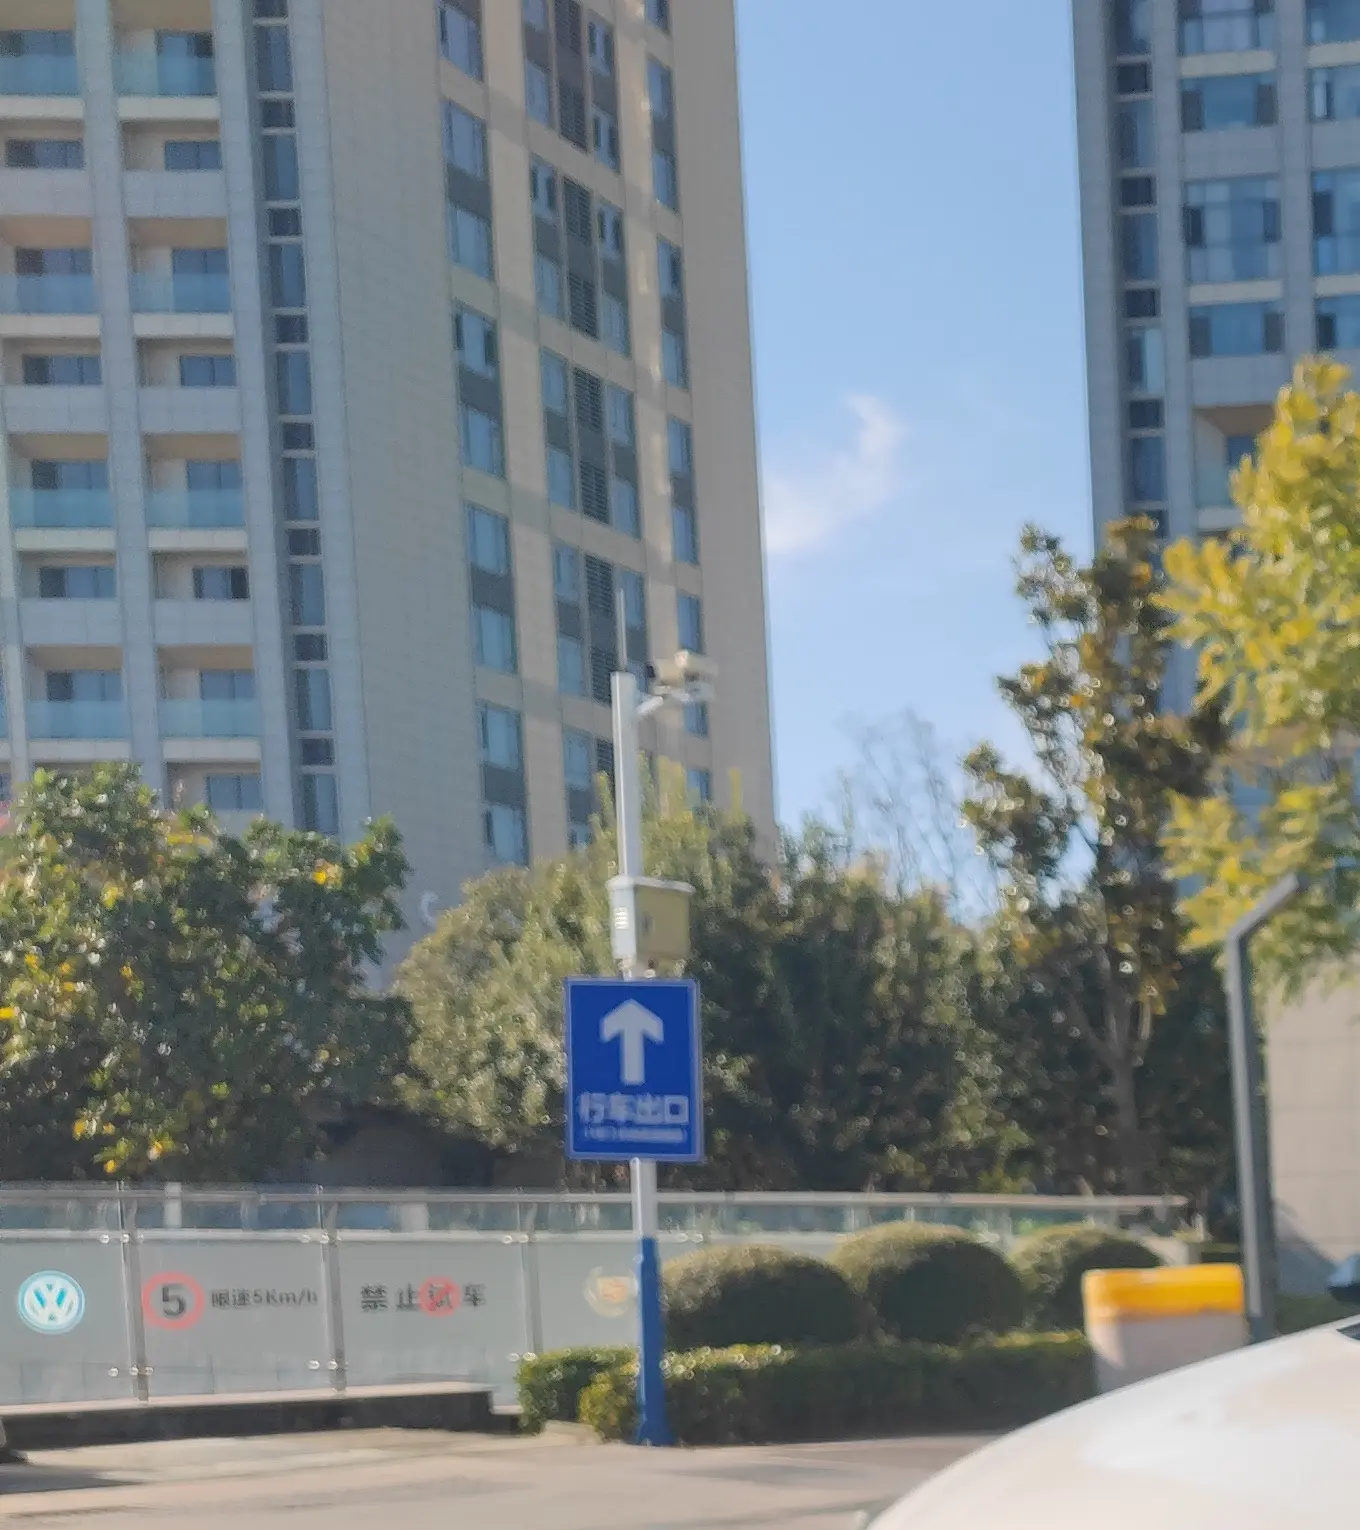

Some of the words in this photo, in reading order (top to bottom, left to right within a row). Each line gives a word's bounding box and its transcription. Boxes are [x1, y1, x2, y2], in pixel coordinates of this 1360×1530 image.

[579, 1091, 690, 1126] 行车出口
[161, 1283, 188, 1318] 5
